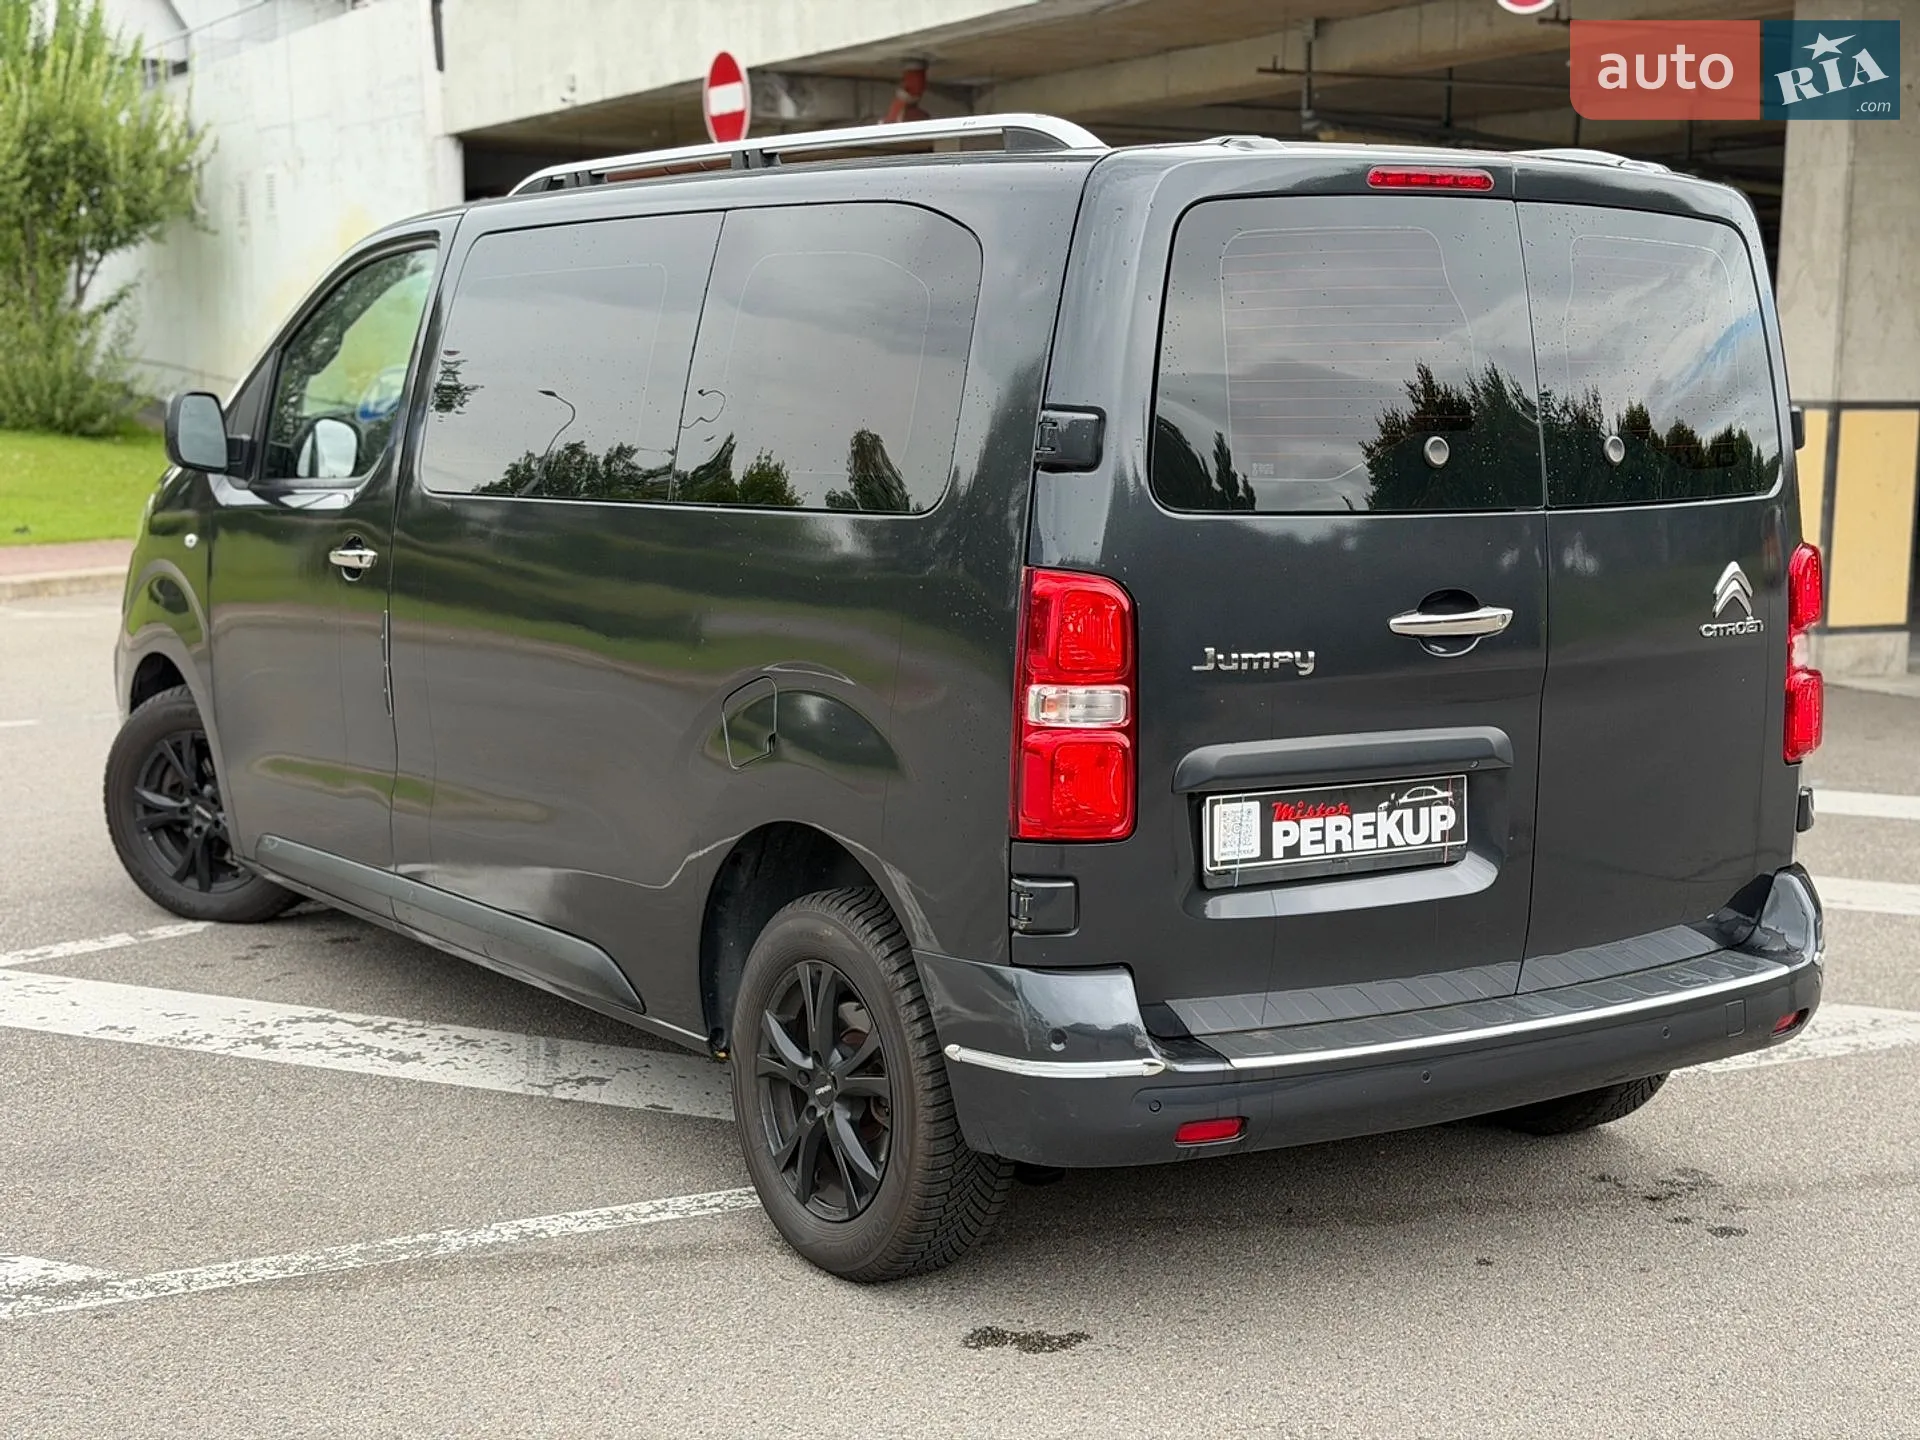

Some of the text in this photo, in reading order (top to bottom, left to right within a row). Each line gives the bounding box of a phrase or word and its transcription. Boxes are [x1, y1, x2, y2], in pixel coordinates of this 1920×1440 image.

[1191, 647, 1315, 676] Jumpy
[1272, 800, 1351, 822] Mister
[1272, 805, 1456, 859] PEREKUP
